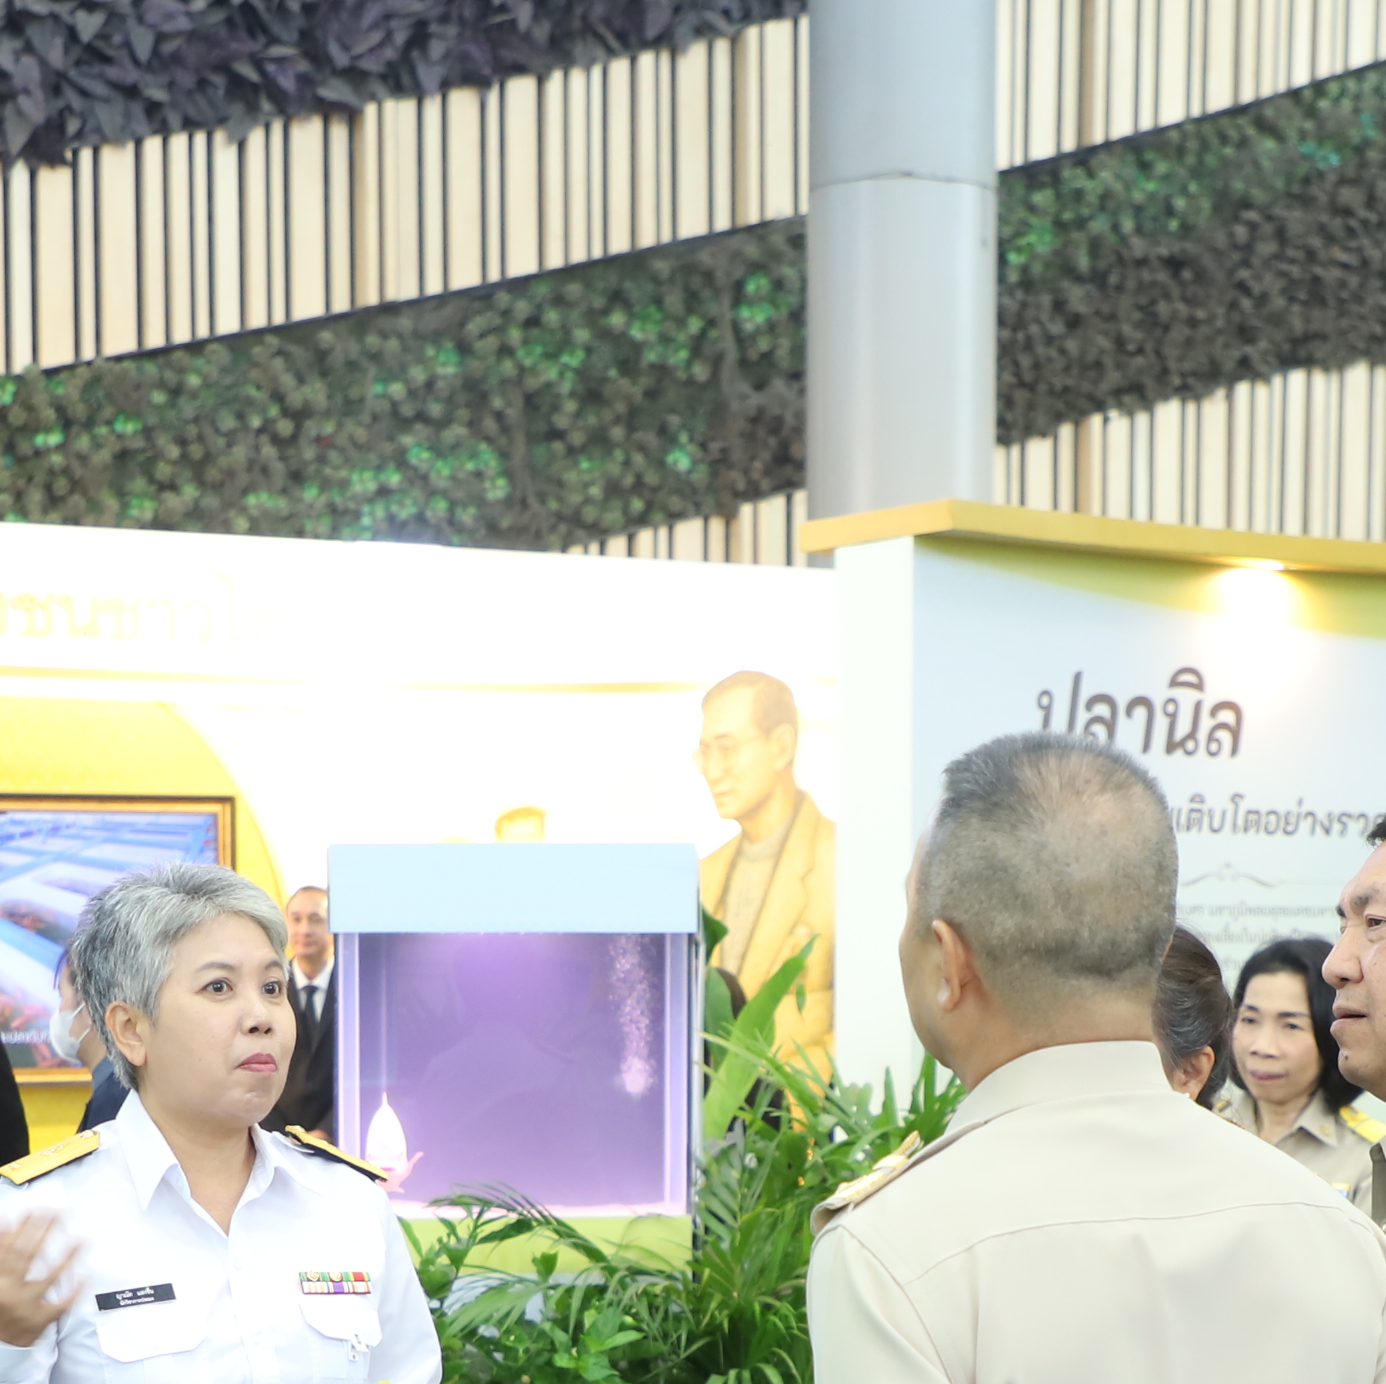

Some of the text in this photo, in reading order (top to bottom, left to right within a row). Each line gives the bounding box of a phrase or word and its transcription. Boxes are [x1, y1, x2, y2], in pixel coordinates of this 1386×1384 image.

[1037, 667, 1244, 758] ปลานิล
[1170, 792, 1385, 837] เติบโตอย่างรว
